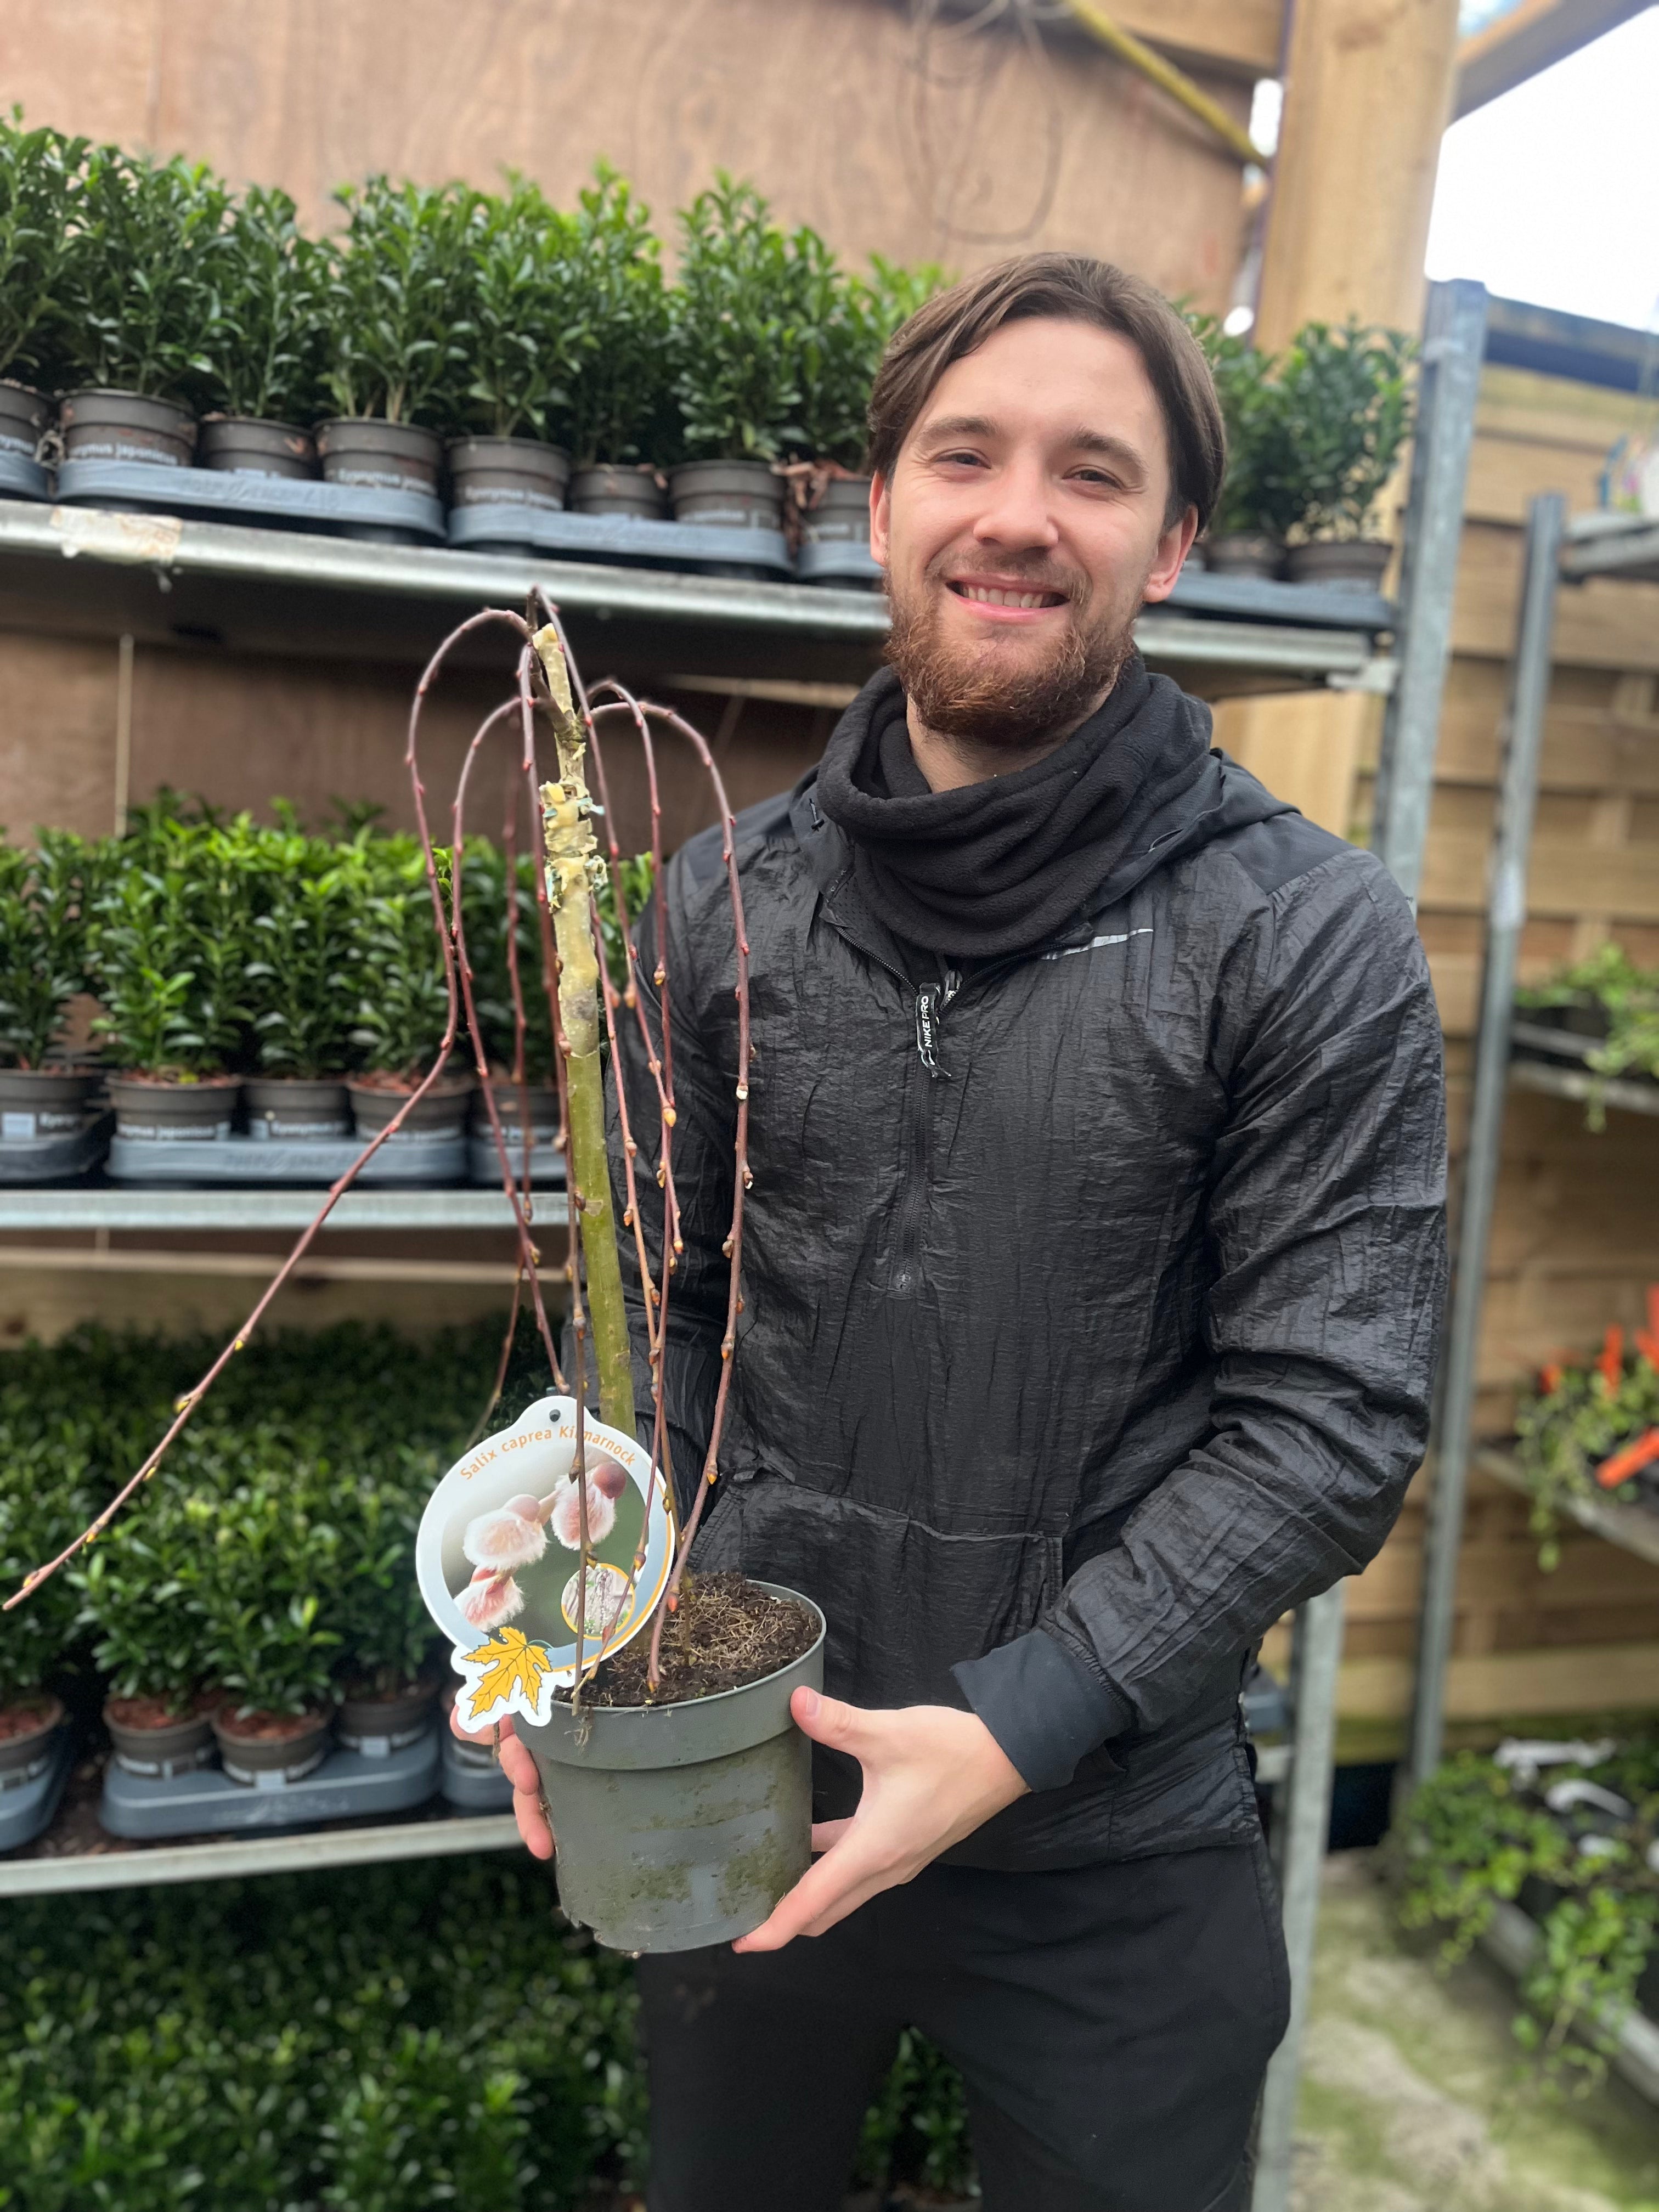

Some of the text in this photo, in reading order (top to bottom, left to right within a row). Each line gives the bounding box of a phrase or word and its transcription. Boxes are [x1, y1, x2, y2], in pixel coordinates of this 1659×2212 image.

[921, 996, 933, 1048] NIKE PRO
[460, 1425, 636, 1480] Salix caprea Kimarnock
